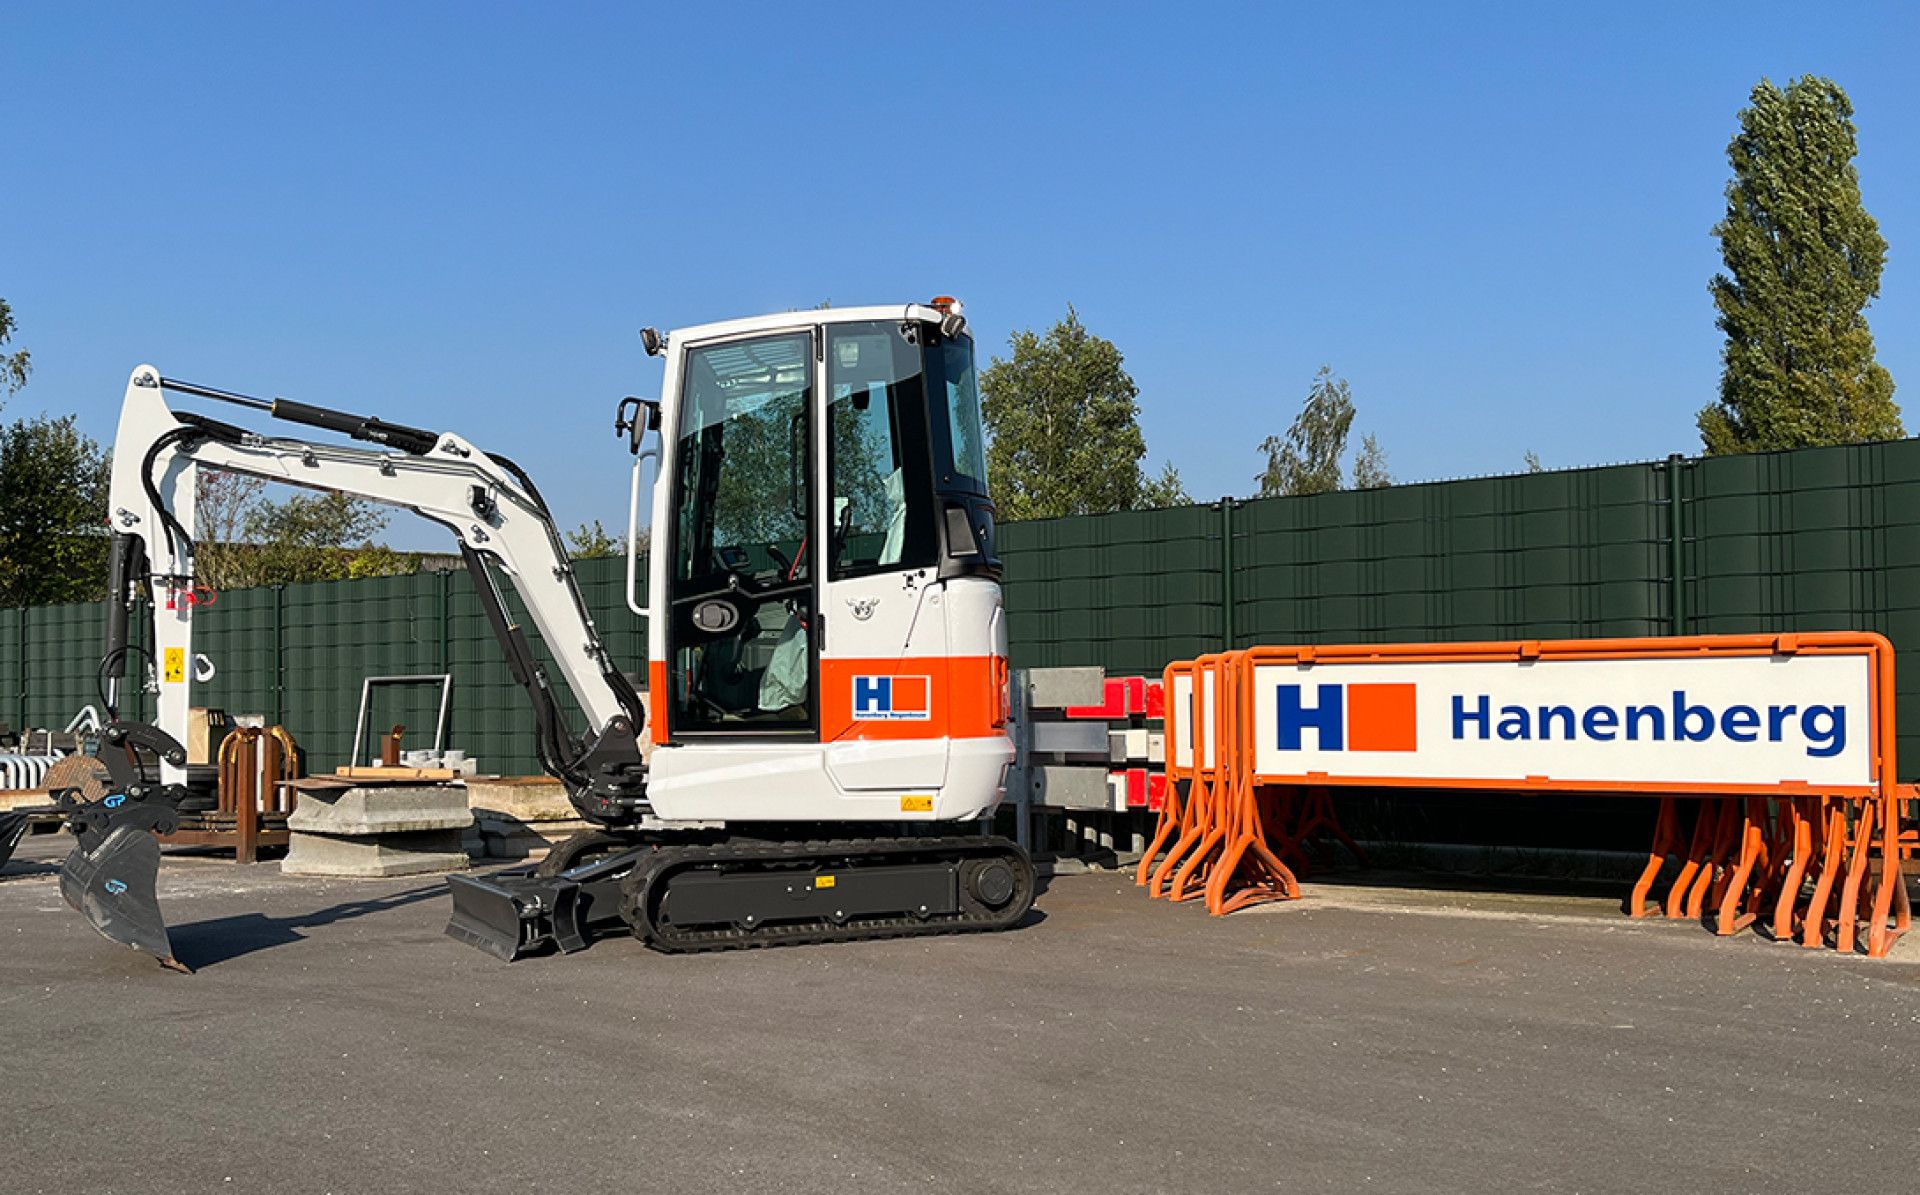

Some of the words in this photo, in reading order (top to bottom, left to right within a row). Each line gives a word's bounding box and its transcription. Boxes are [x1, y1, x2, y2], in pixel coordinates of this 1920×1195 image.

[855, 677, 891, 711] H
[1277, 684, 1343, 751] H
[1452, 691, 1846, 757] Hanenberg
